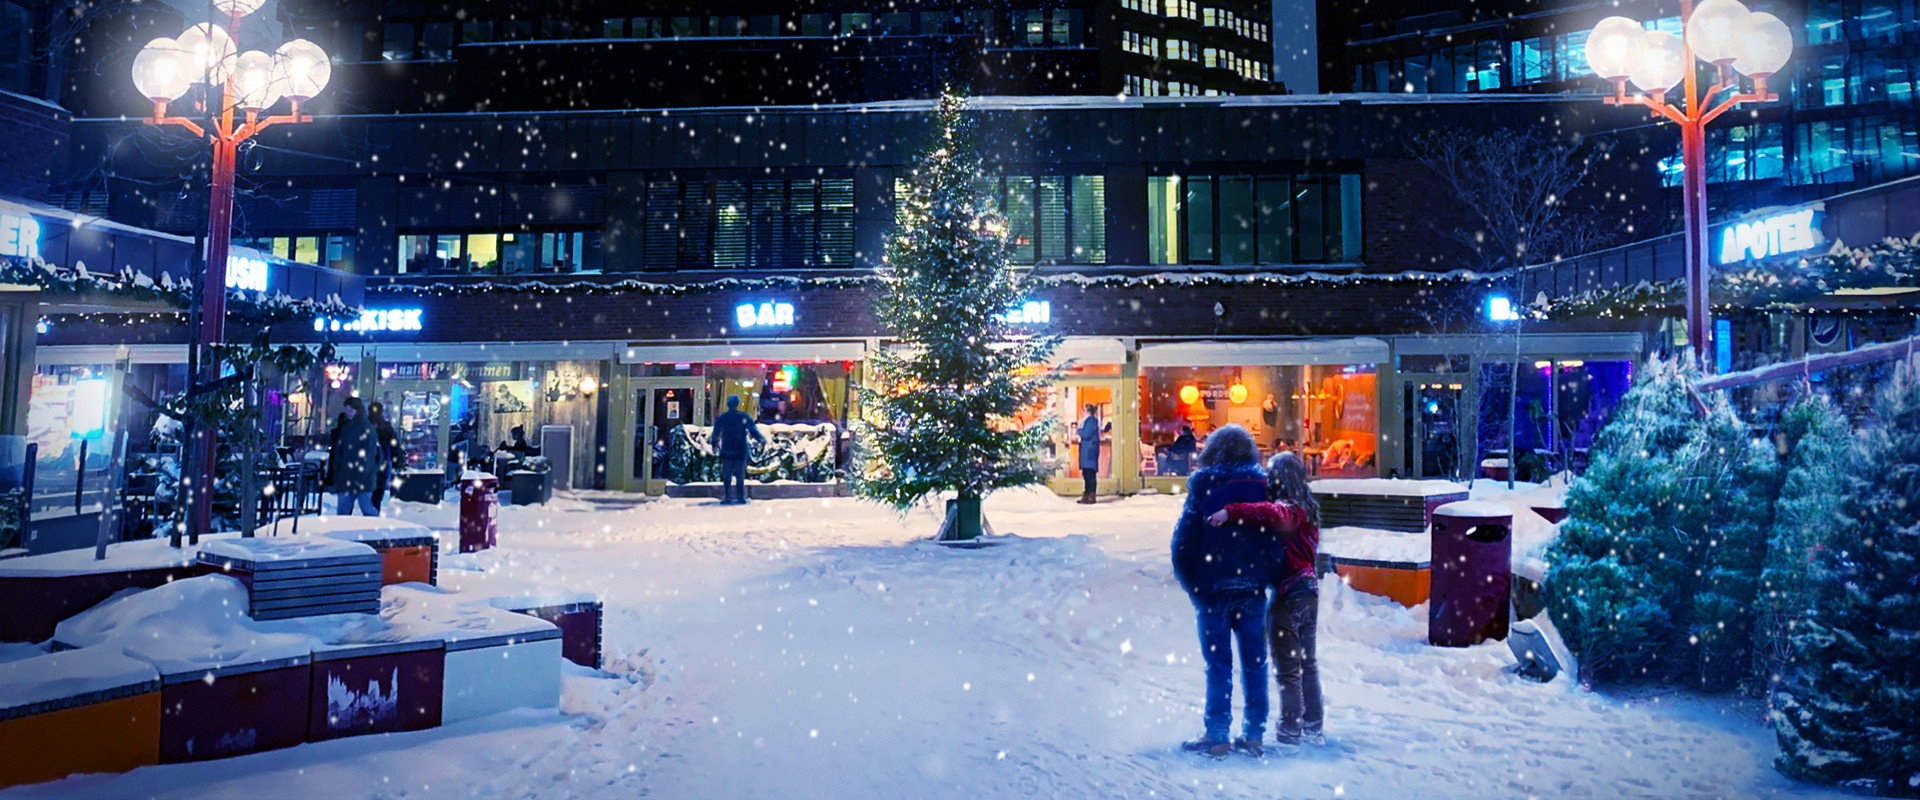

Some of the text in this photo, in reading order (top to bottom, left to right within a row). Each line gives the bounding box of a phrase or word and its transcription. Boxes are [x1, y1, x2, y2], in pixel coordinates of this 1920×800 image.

[1721, 209, 1815, 264] APOTEK
[225, 255, 268, 292] USHI
[314, 309, 422, 331] KISK
[736, 302, 795, 328] BAR
